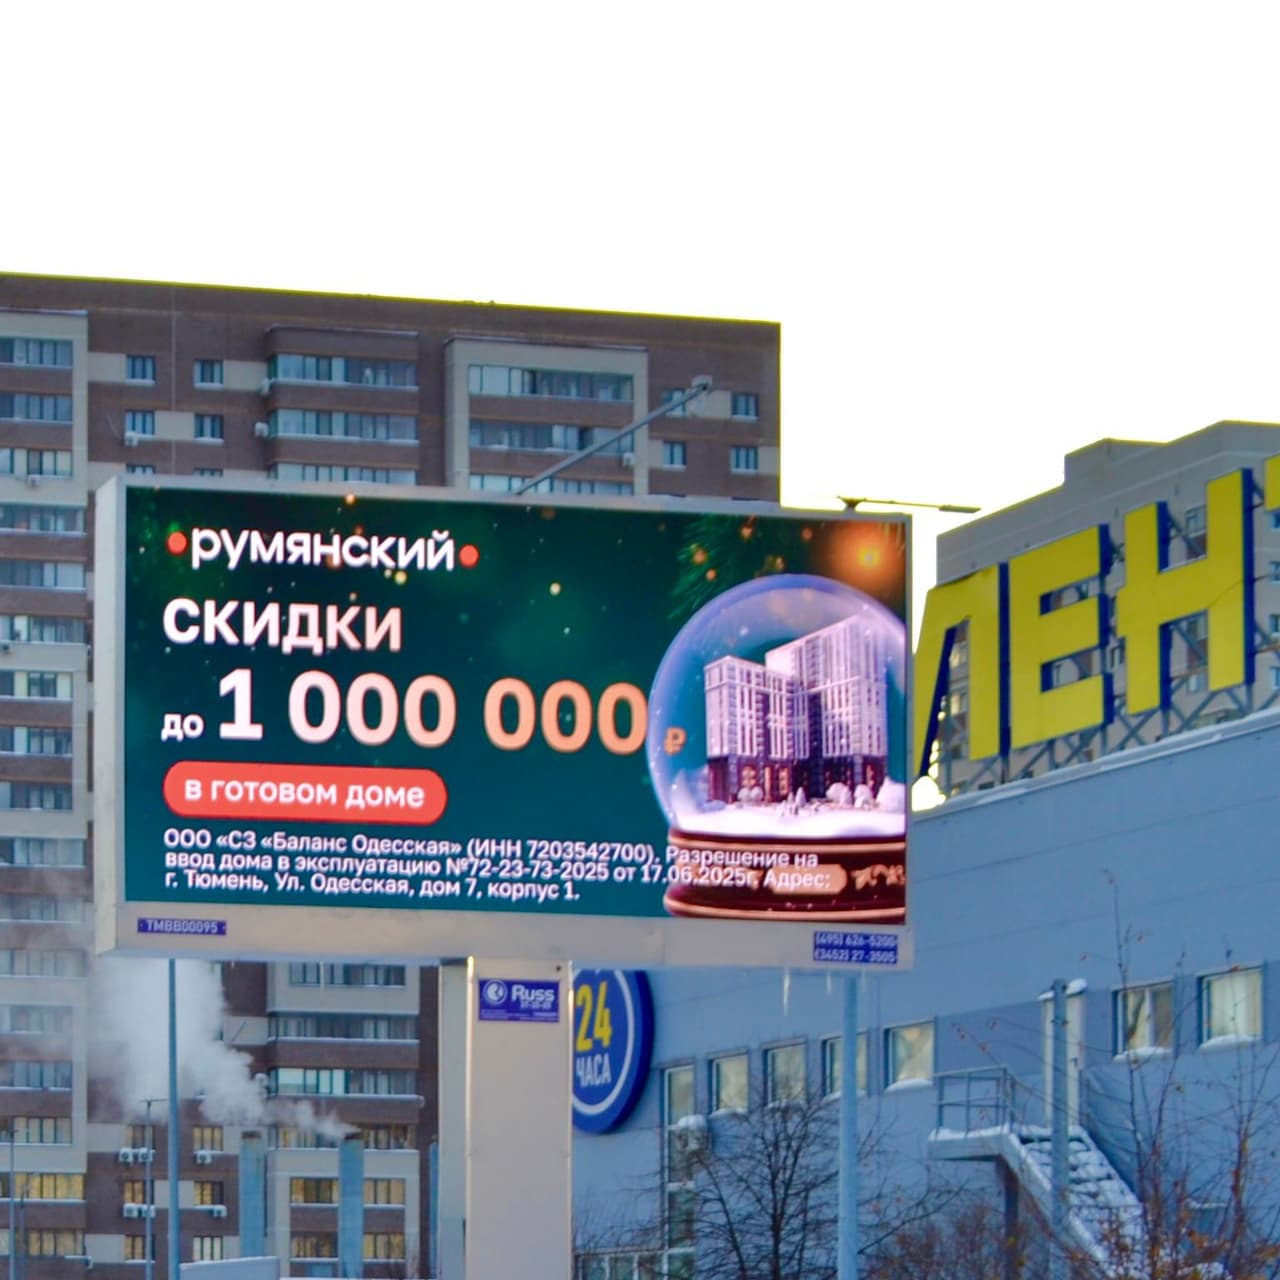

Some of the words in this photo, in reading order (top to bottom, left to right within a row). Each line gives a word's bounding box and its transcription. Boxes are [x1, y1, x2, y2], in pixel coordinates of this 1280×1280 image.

[191, 527, 456, 571] румянский
[912, 454, 1280, 777] ЛЕН
[160, 713, 204, 741] до
[218, 668, 263, 740] 1
[288, 669, 457, 748] 000
[483, 677, 649, 756] 000
[185, 780, 202, 800] в
[211, 780, 337, 806] готовом
[345, 785, 425, 809] доме
[163, 828, 211, 848] ООО
[261, 832, 346, 852] «Баланс
[352, 834, 461, 856] Одесская»
[467, 838, 521, 859] (ИНН
[666, 847, 790, 870] Разрешение
[794, 853, 818, 868] на
[165, 852, 214, 870] ввод
[220, 853, 272, 871] дома
[278, 856, 290, 870] в
[295, 856, 440, 877] эксплуатацию
[613, 866, 635, 881] от
[763, 873, 831, 889] Адрес:
[165, 872, 178, 888] г.
[184, 870, 269, 892] Тюмень,
[274, 873, 305, 891] Ул.
[310, 874, 414, 895] Одесская,
[419, 880, 460, 897] дом
[465, 879, 482, 899] 7,
[488, 882, 559, 902] корпус
[563, 881, 580, 900] 1.
[511, 984, 555, 1002] Russ
[576, 981, 612, 1052] 24
[576, 1053, 611, 1088] ЧАСА
